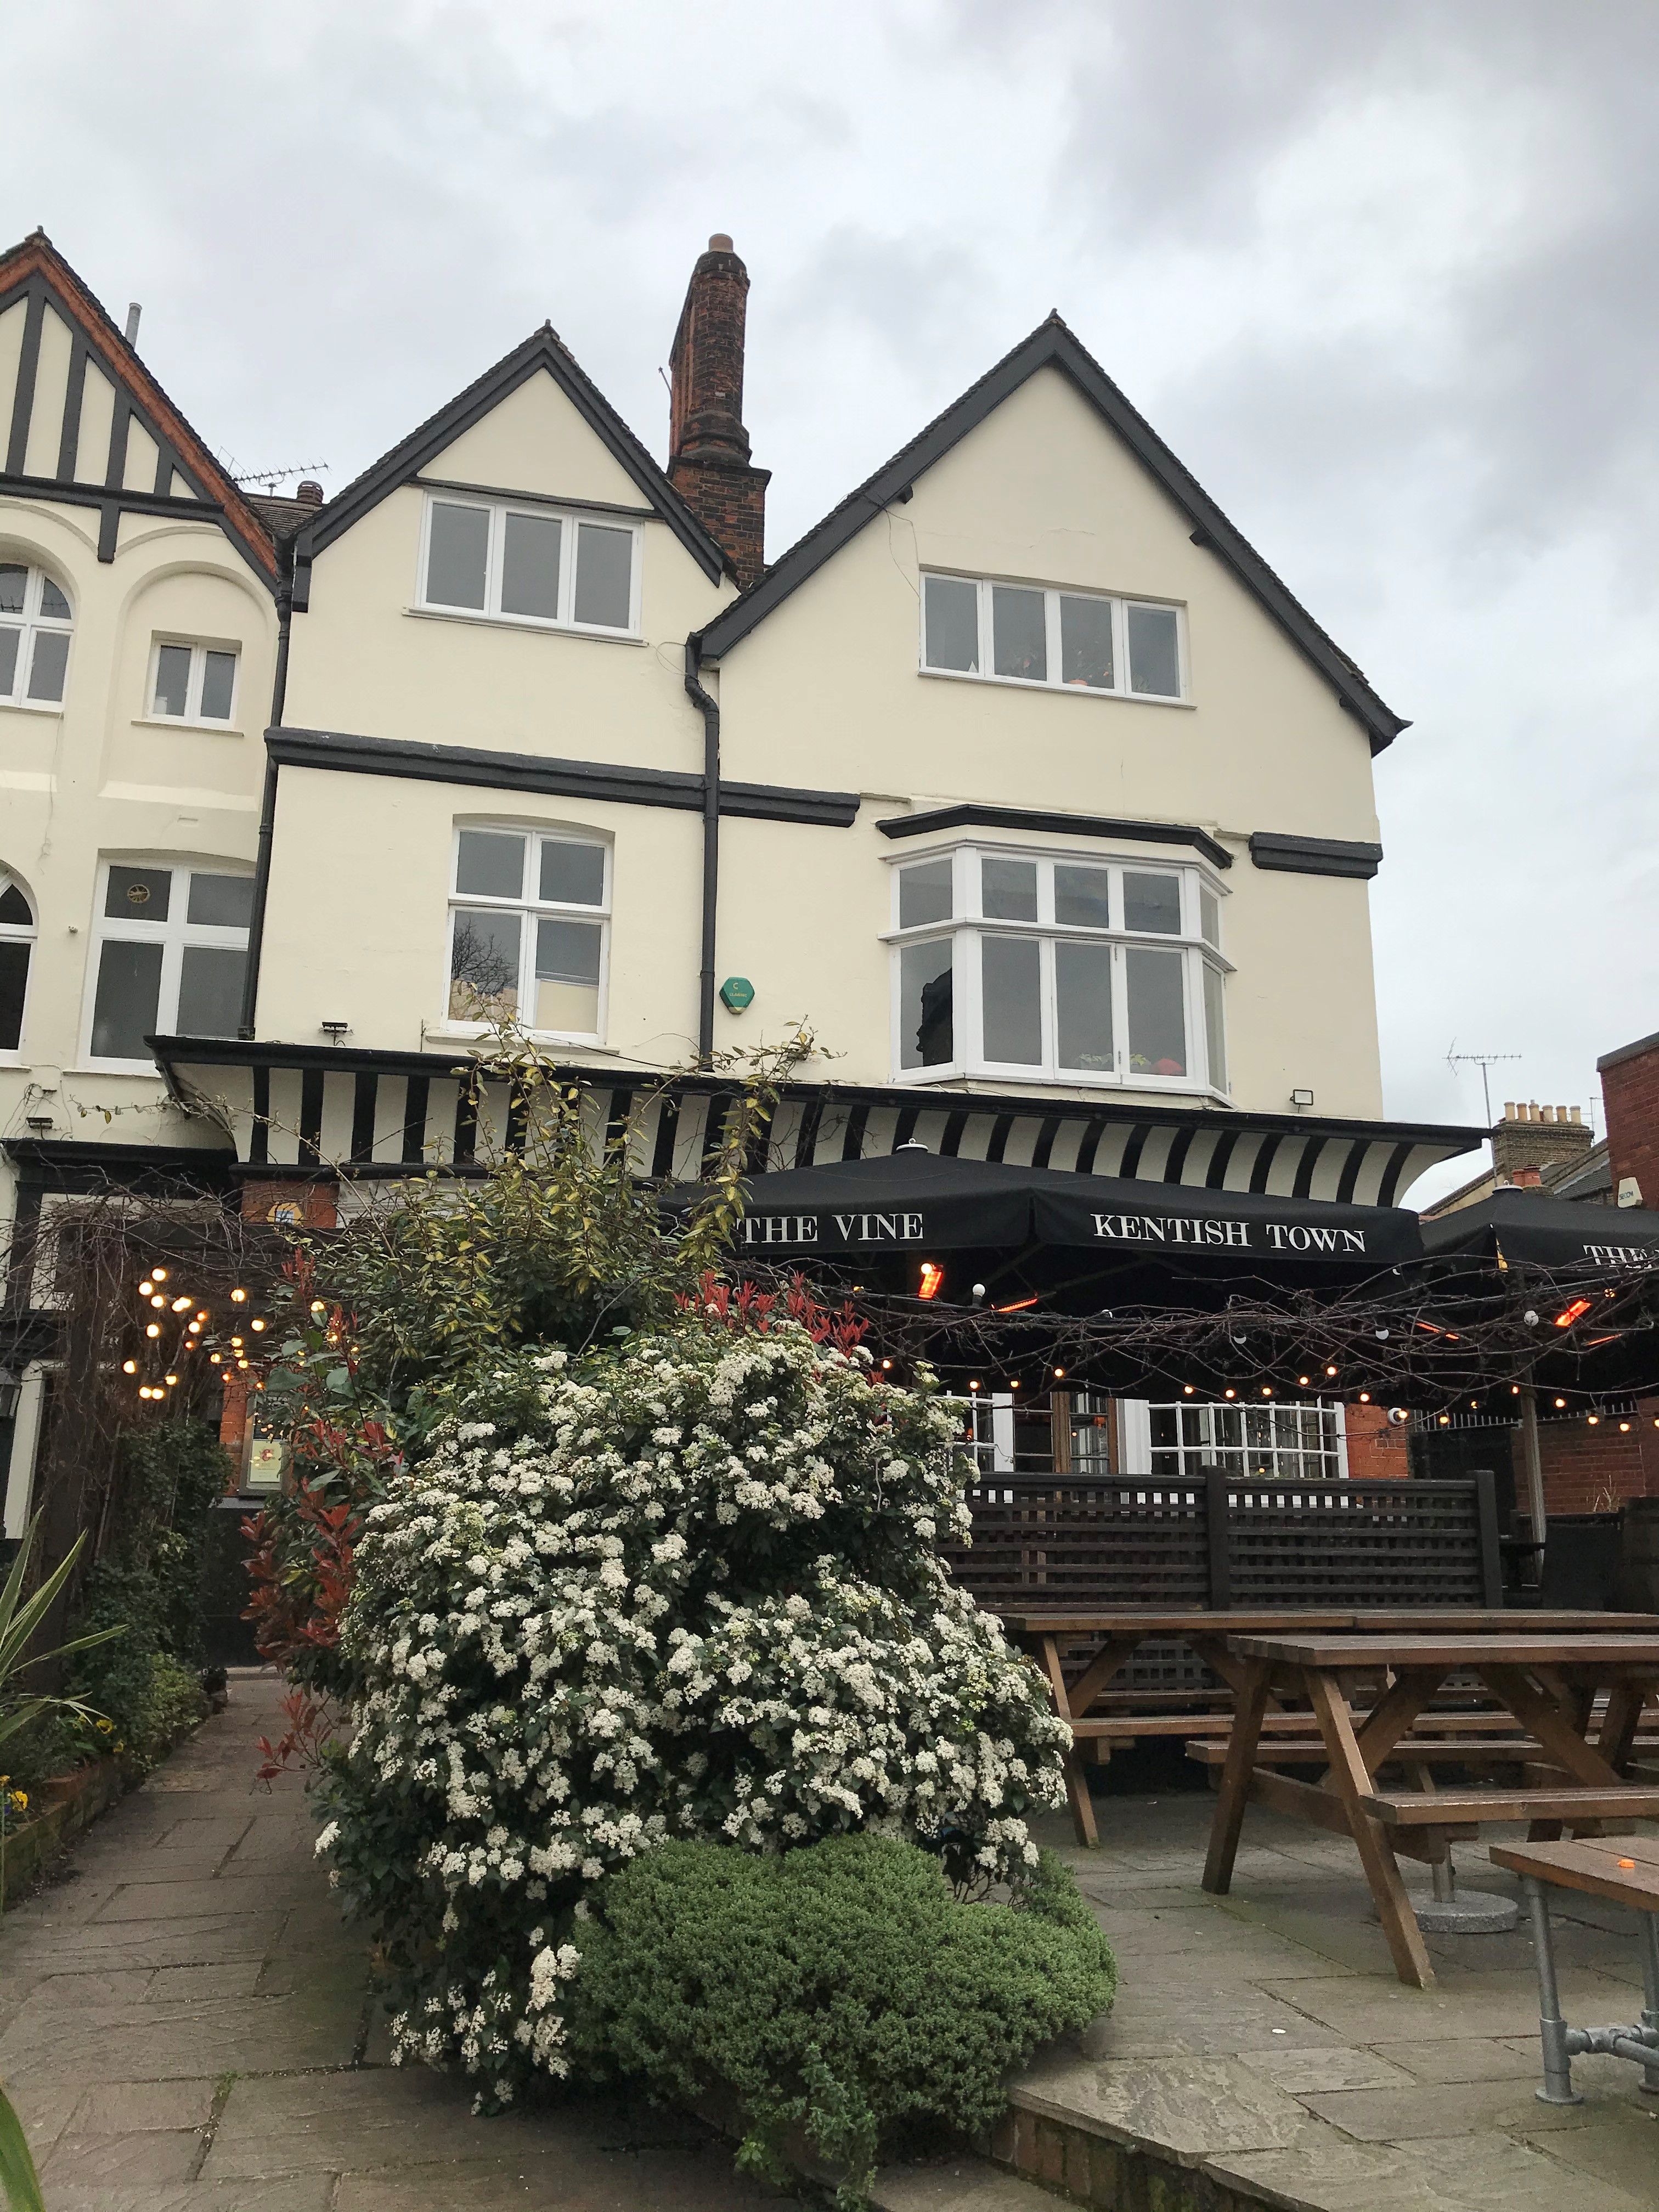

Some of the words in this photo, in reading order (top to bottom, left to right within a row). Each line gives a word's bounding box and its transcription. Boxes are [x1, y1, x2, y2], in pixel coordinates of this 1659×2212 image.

[736, 1215, 818, 1243] THE
[832, 1212, 924, 1241] VINE
[1090, 1214, 1252, 1247] KENTISH
[1266, 1223, 1365, 1252] TOWN
[1583, 1244, 1652, 1269] THE
